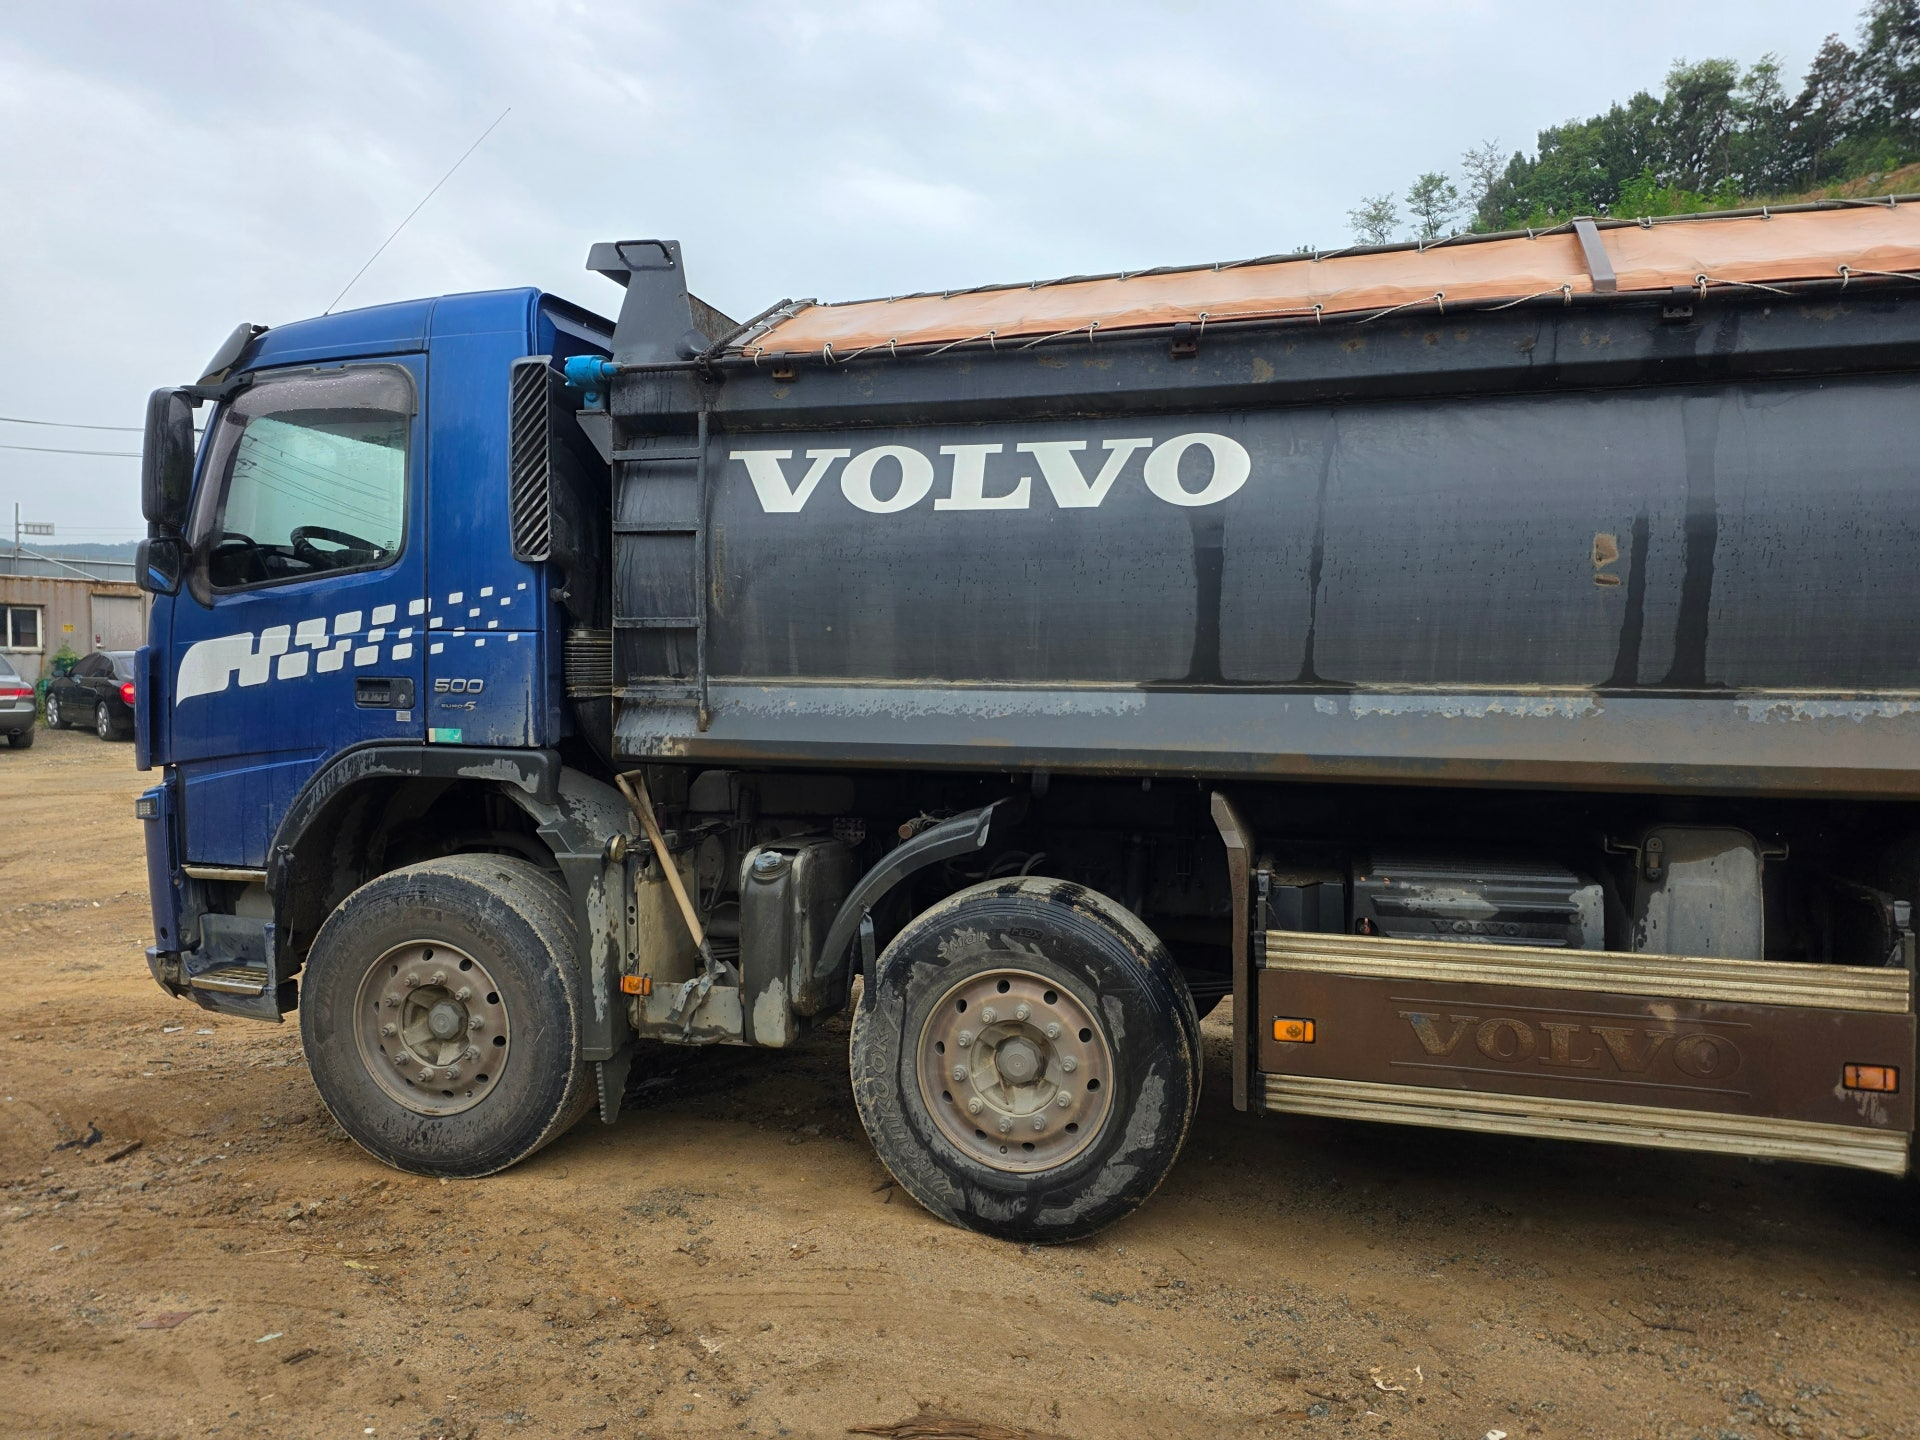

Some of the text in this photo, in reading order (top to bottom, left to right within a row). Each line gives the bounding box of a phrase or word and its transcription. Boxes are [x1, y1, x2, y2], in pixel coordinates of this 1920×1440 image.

[729, 432, 1251, 514] VOLVO
[434, 678, 484, 694] 500
[1430, 918, 1521, 937] VOLVO
[1398, 1010, 1743, 1080] VOLVO
